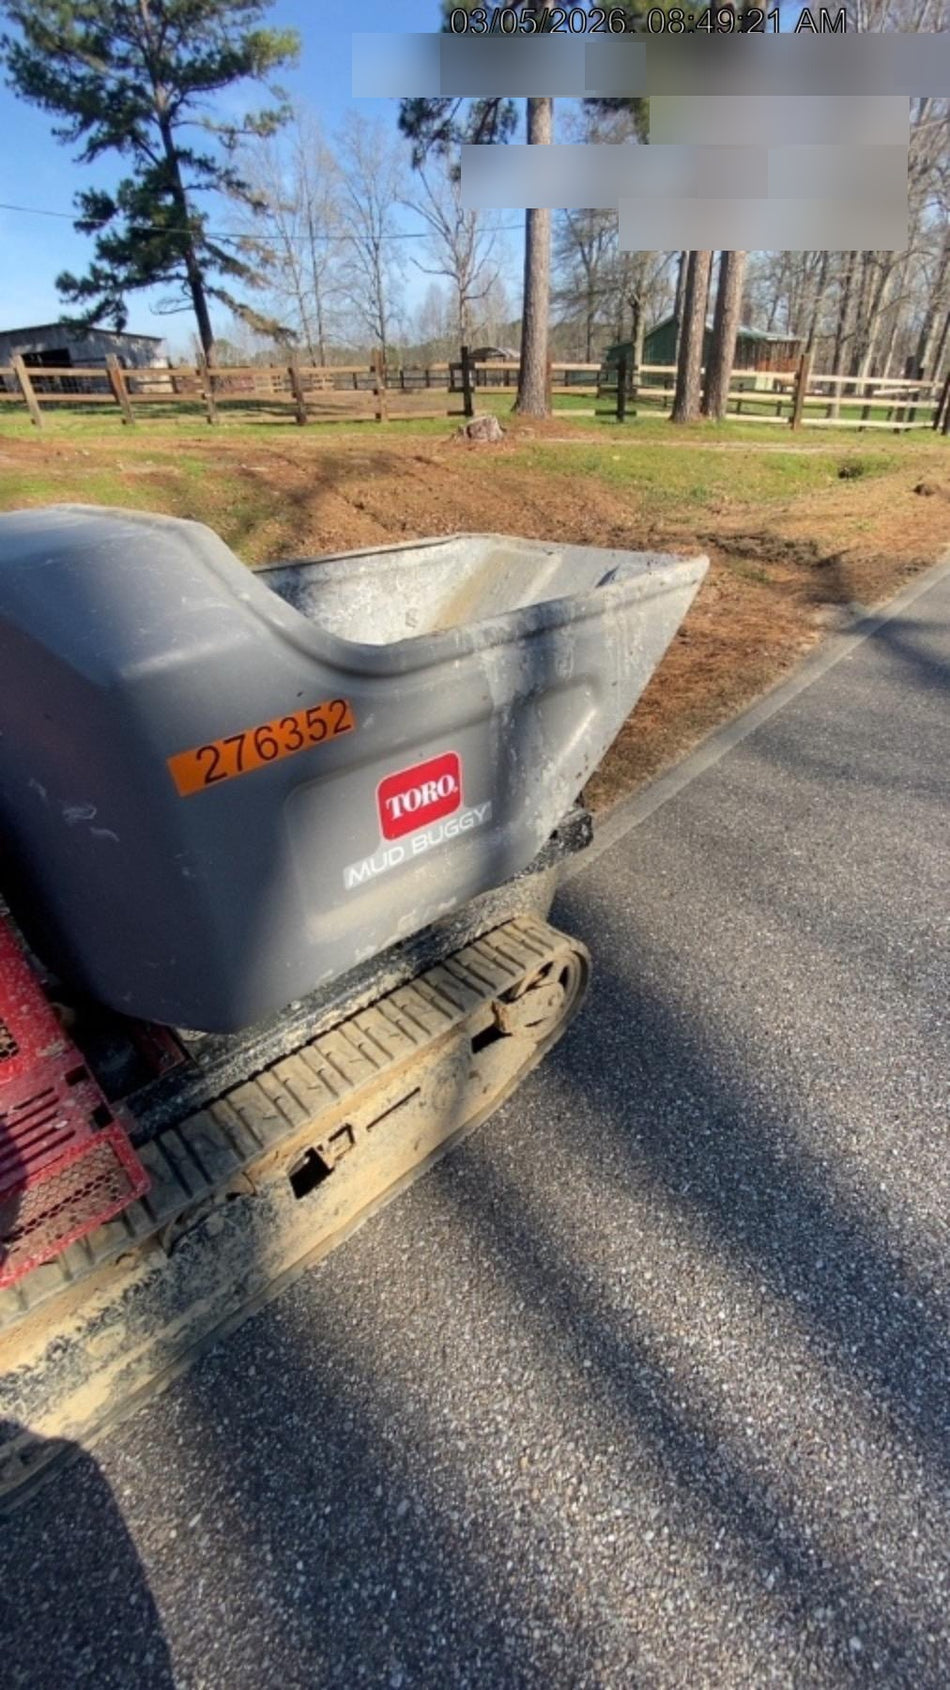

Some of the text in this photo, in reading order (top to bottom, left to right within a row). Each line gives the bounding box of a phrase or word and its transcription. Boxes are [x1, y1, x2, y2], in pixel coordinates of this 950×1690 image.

[196, 699, 352, 784] 276352
[385, 774, 456, 821] TORO
[348, 801, 491, 887] MUD BUGGY
